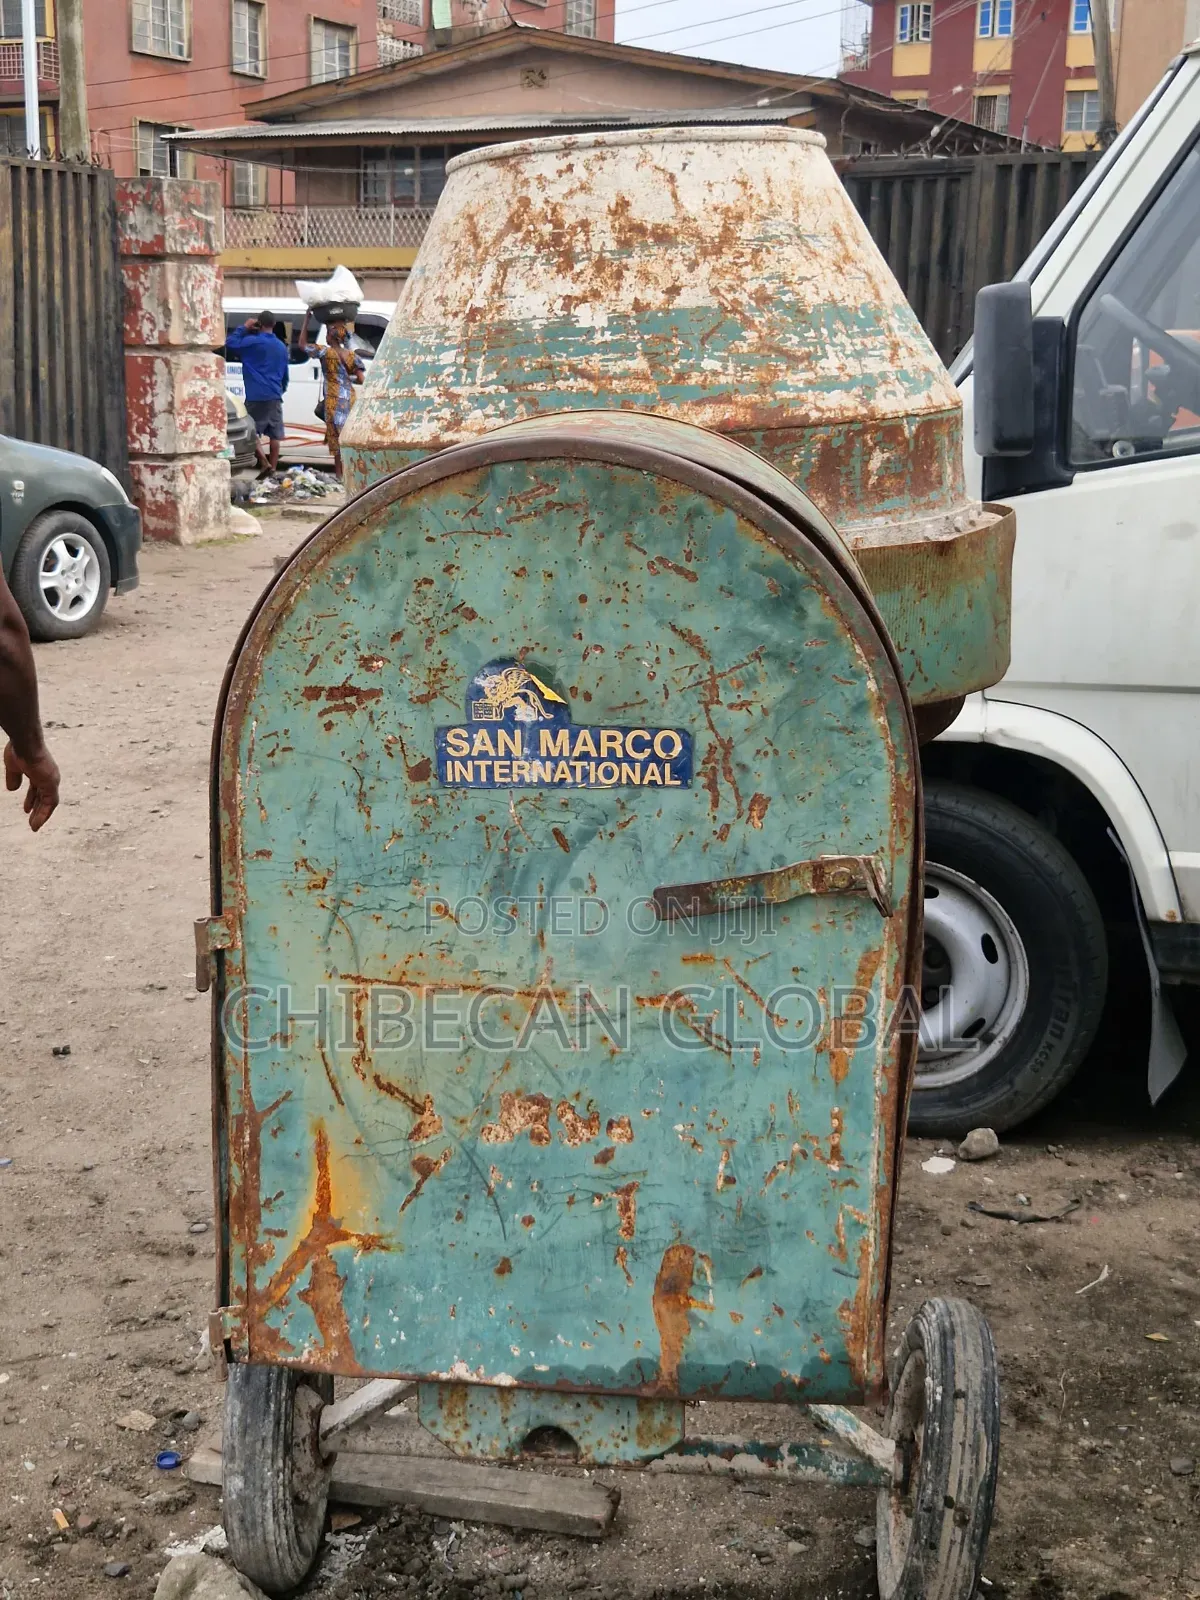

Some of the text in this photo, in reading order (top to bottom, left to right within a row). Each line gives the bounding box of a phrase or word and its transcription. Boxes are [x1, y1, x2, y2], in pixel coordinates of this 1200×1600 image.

[446, 728, 682, 759] SAN MARCO
[446, 760, 682, 786] INTERNATIONAL
